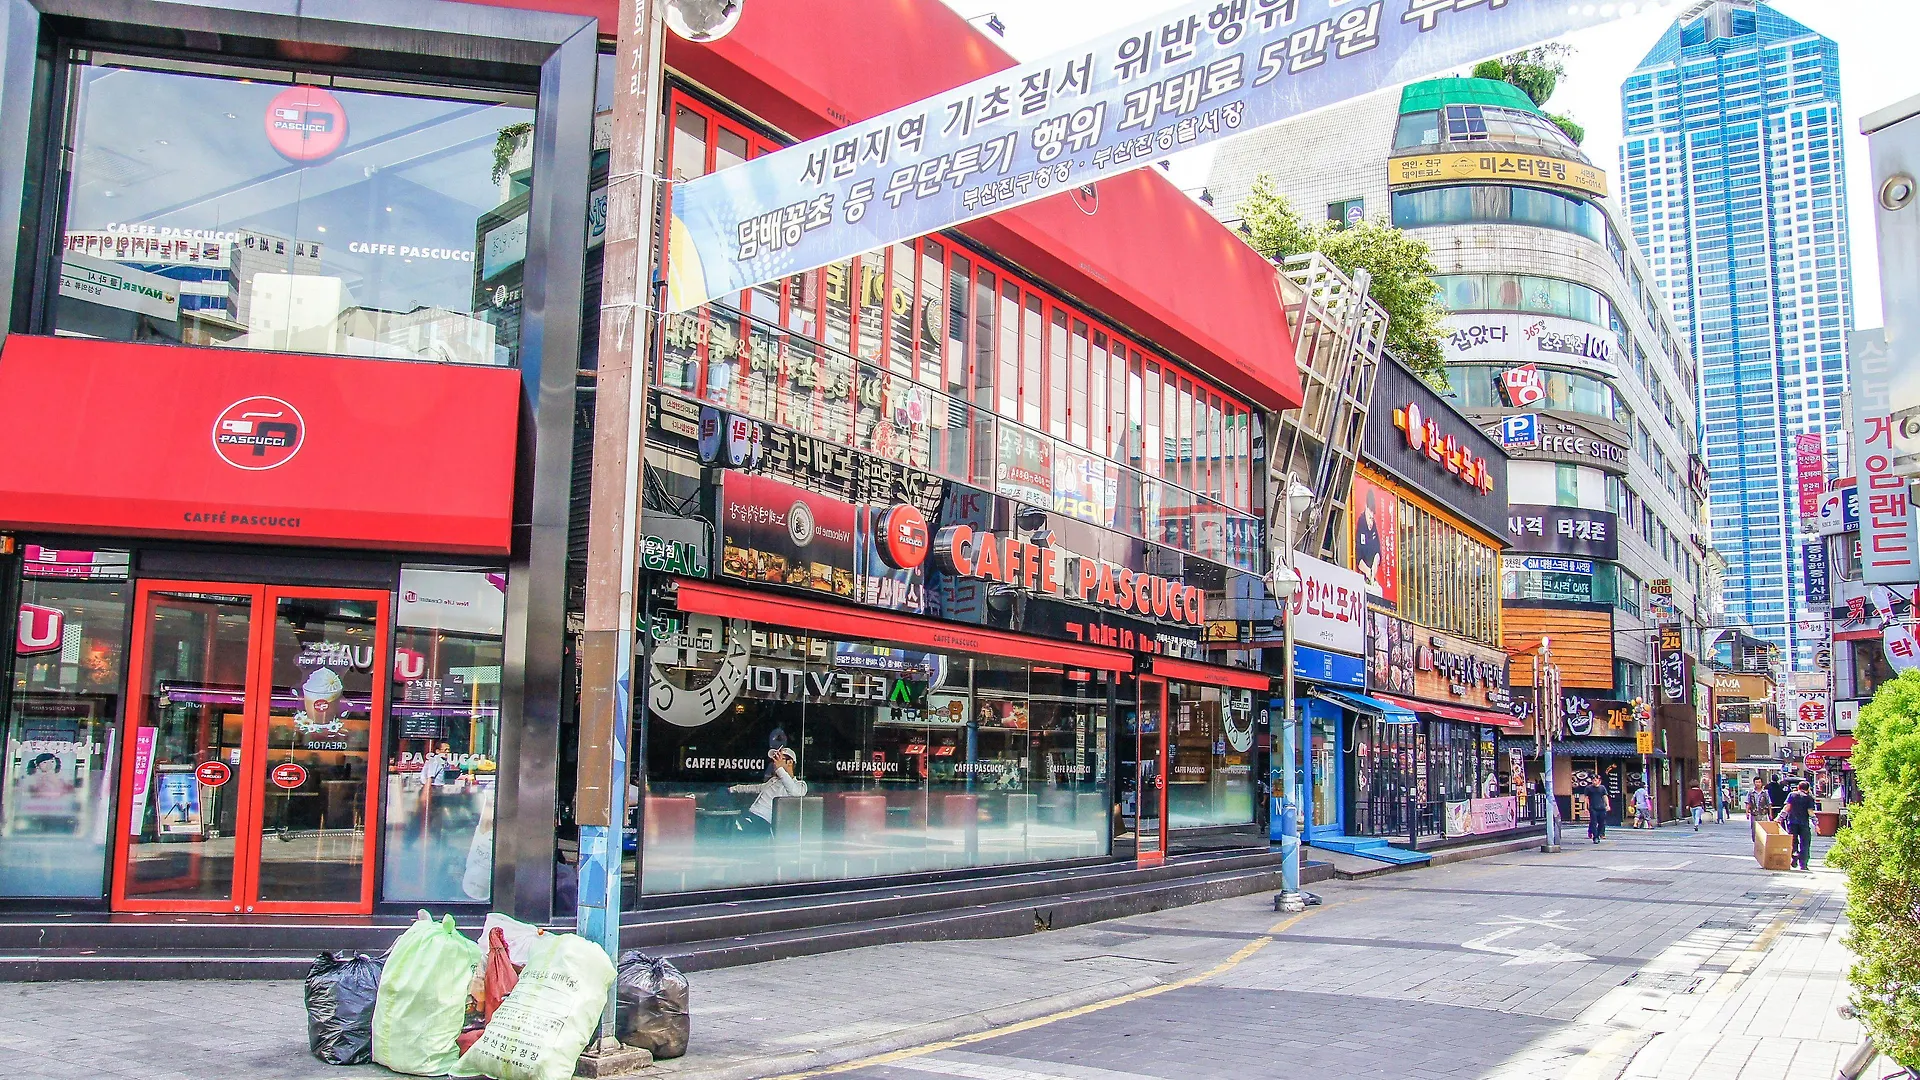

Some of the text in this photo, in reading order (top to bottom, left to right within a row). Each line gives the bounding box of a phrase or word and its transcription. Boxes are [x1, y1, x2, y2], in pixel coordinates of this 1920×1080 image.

[799, 0, 1299, 187] 서면지역 기초질서 위반행위
[274, 120, 326, 133] PASCUCCI
[737, 195, 833, 262] 담배꽁초
[843, 181, 874, 224] 등
[884, 131, 1018, 206] 무단투기
[1033, 101, 1106, 161] 행위
[1117, 53, 1245, 132] 과태료
[1252, 0, 1384, 89] 5만원
[963, 101, 1245, 211] 부산진구청장 부산진경찰서장
[1401, 158, 1441, 170] 연인 친구
[1402, 168, 1441, 179] 데이트코스
[1479, 157, 1567, 181] 미스터힐링
[160, 226, 239, 244] PASCUCCI
[349, 241, 396, 256] CAFFE
[399, 245, 476, 263] PASCUCCI
[1450, 325, 1508, 351] 잡았다
[1541, 333, 1563, 351] 소주
[1506, 367, 1544, 404] 땡
[1508, 418, 1529, 438] P
[1557, 424, 1576, 434] 카페
[218, 434, 286, 447] PASCUCCI
[1424, 416, 1488, 497] 한신포차
[1591, 441, 1625, 463] SHOP
[183, 511, 300, 528] CAFFÉ PASCUCCI
[1557, 518, 1606, 542] 타겟존
[899, 535, 923, 547] PASCUCCI
[1528, 558, 1540, 569] 6M
[1078, 556, 1205, 628] PASCUCCI
[1306, 575, 1363, 627] 한신포차
[1661, 636, 1681, 649] 24
[1607, 709, 1624, 730] 24
[401, 751, 486, 766] PASCUCCI
[685, 757, 765, 770] CAFFE PASCUCCI
[836, 761, 899, 773] CAFFE PASCUCCI
[954, 763, 1005, 774] CAFFE PASCUCCI
[1049, 764, 1065, 774] CAFFE
